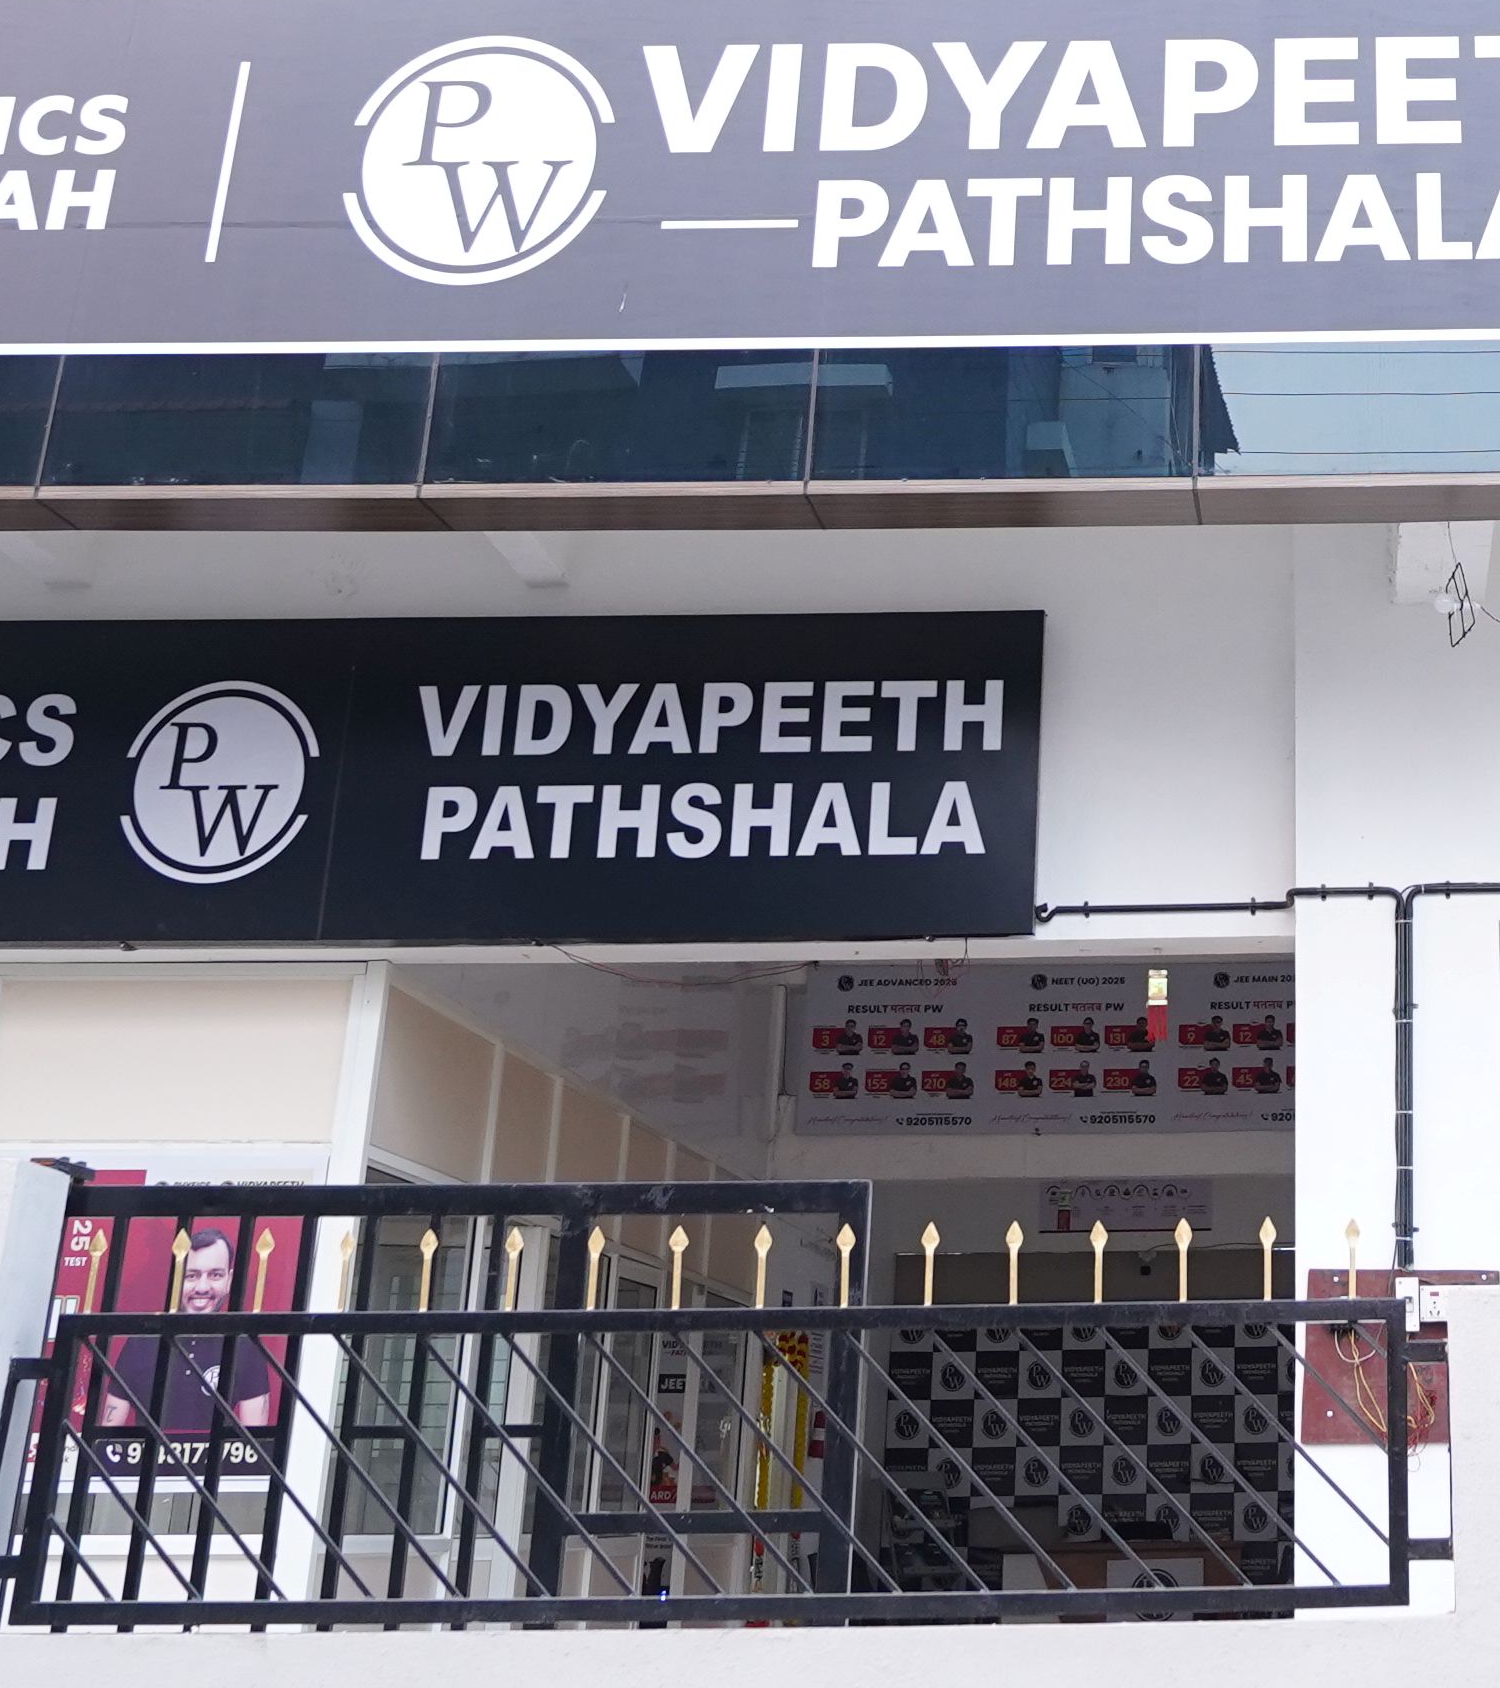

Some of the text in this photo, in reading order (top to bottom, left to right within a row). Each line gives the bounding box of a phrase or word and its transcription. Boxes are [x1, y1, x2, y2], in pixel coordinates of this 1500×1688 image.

[420, 680, 1003, 756] VIDYAPEETH
[421, 781, 985, 859] PATHSHALA
[876, 978, 932, 987] ADVANCED
[1052, 977, 1075, 985] NEET
[1077, 976, 1099, 986] (UG)
[1252, 975, 1278, 983] MAIN
[1280, 975, 1295, 983] 20
[848, 1005, 888, 1013] RESULT
[924, 1005, 943, 1013] PW
[1029, 1003, 1070, 1012] RESULT
[1105, 1003, 1125, 1012] PW
[1210, 1001, 1251, 1010] RESULT
[821, 1035, 830, 1046] 3
[874, 1035, 886, 1046] 12
[929, 1034, 946, 1045] 48
[1002, 1034, 1018, 1045] 87
[1053, 1033, 1074, 1044] 100
[1187, 1032, 1195, 1043] 9
[1239, 1032, 1252, 1042] 12
[815, 1078, 831, 1090] 58
[867, 1078, 888, 1090] 155
[924, 1078, 946, 1090] 210
[1051, 1077, 1072, 1088] 224
[1106, 1077, 1129, 1087] 230
[1183, 1076, 1199, 1087] 22
[1236, 1075, 1253, 1085] 45
